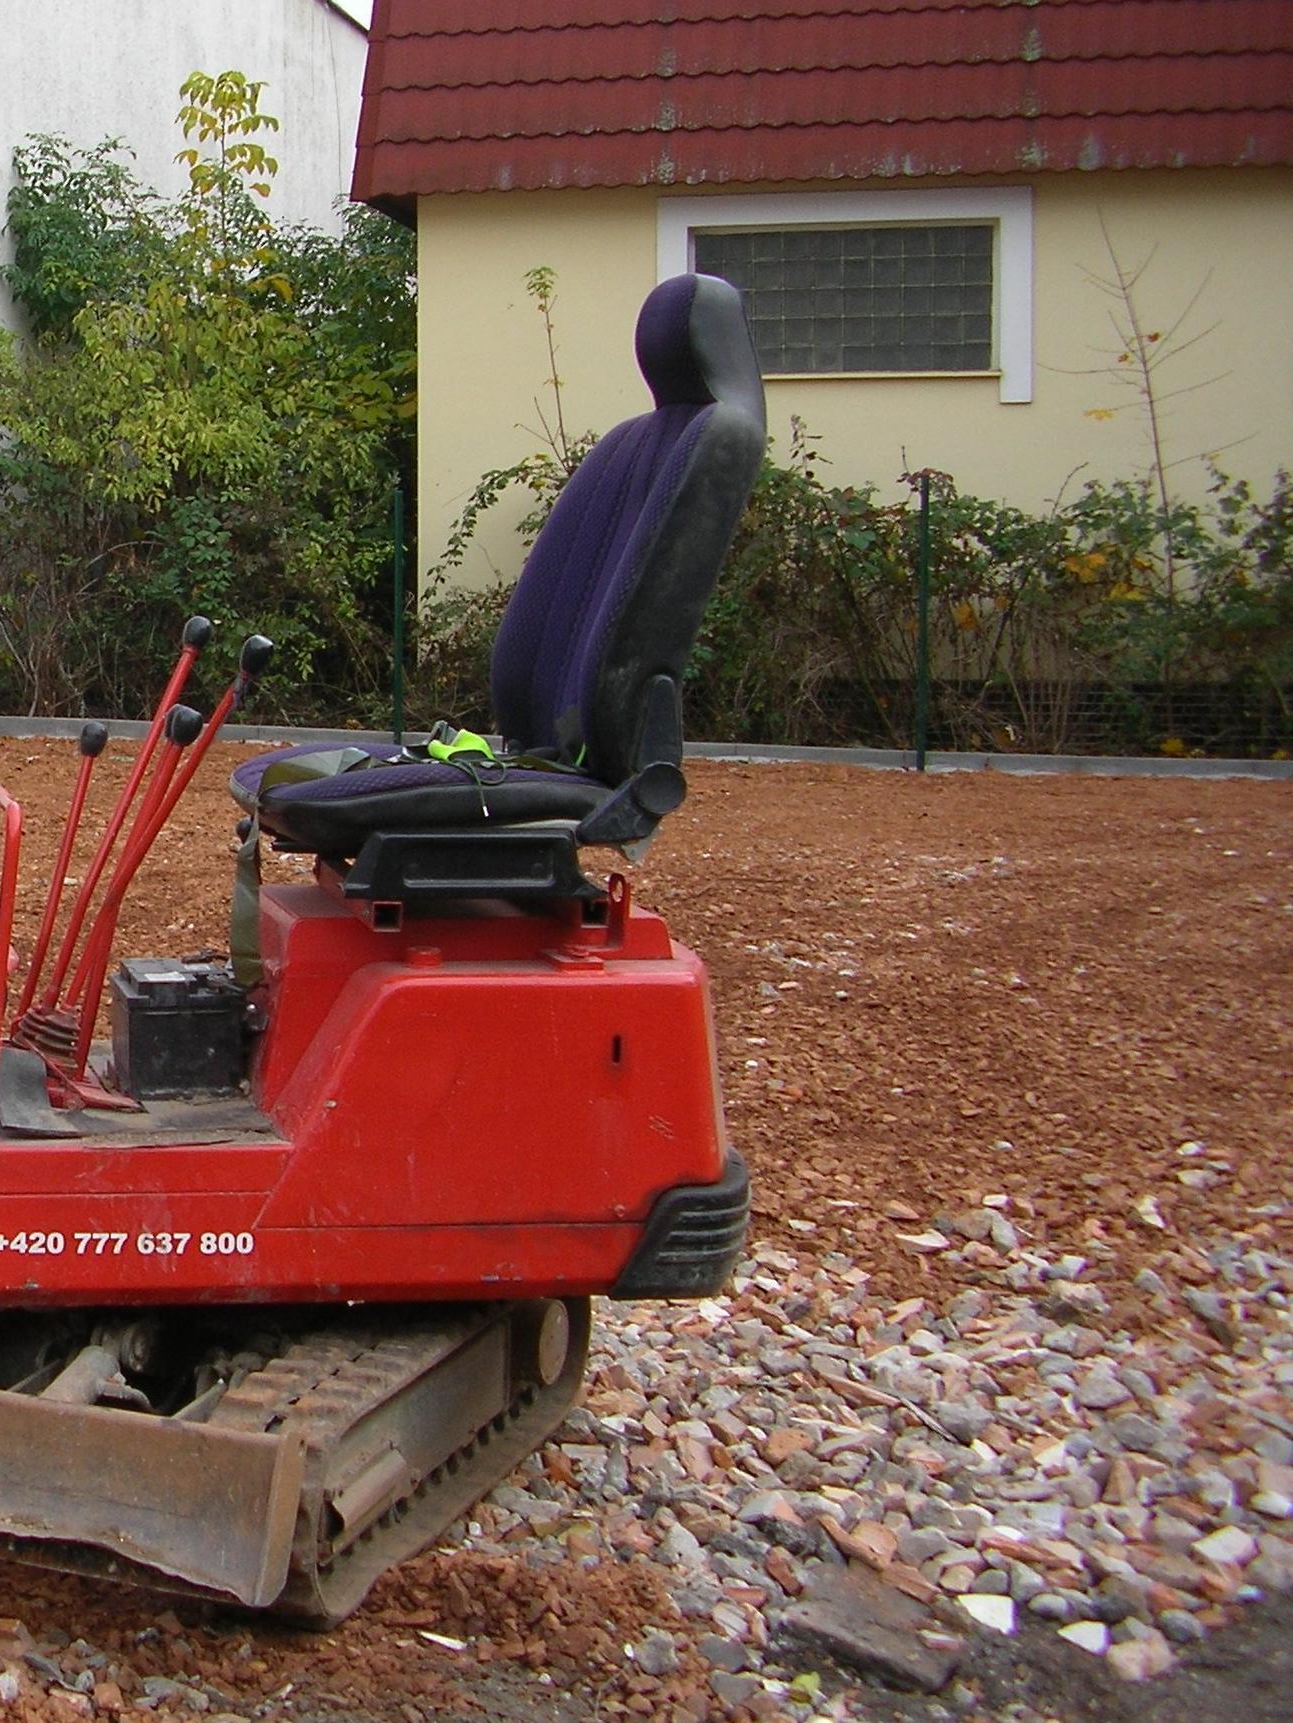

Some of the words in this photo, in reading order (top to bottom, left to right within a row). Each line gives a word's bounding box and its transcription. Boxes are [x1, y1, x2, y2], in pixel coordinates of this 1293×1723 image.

[73, 1233, 128, 1254] 777
[136, 1232, 192, 1254] 637
[199, 1232, 255, 1254] 800
